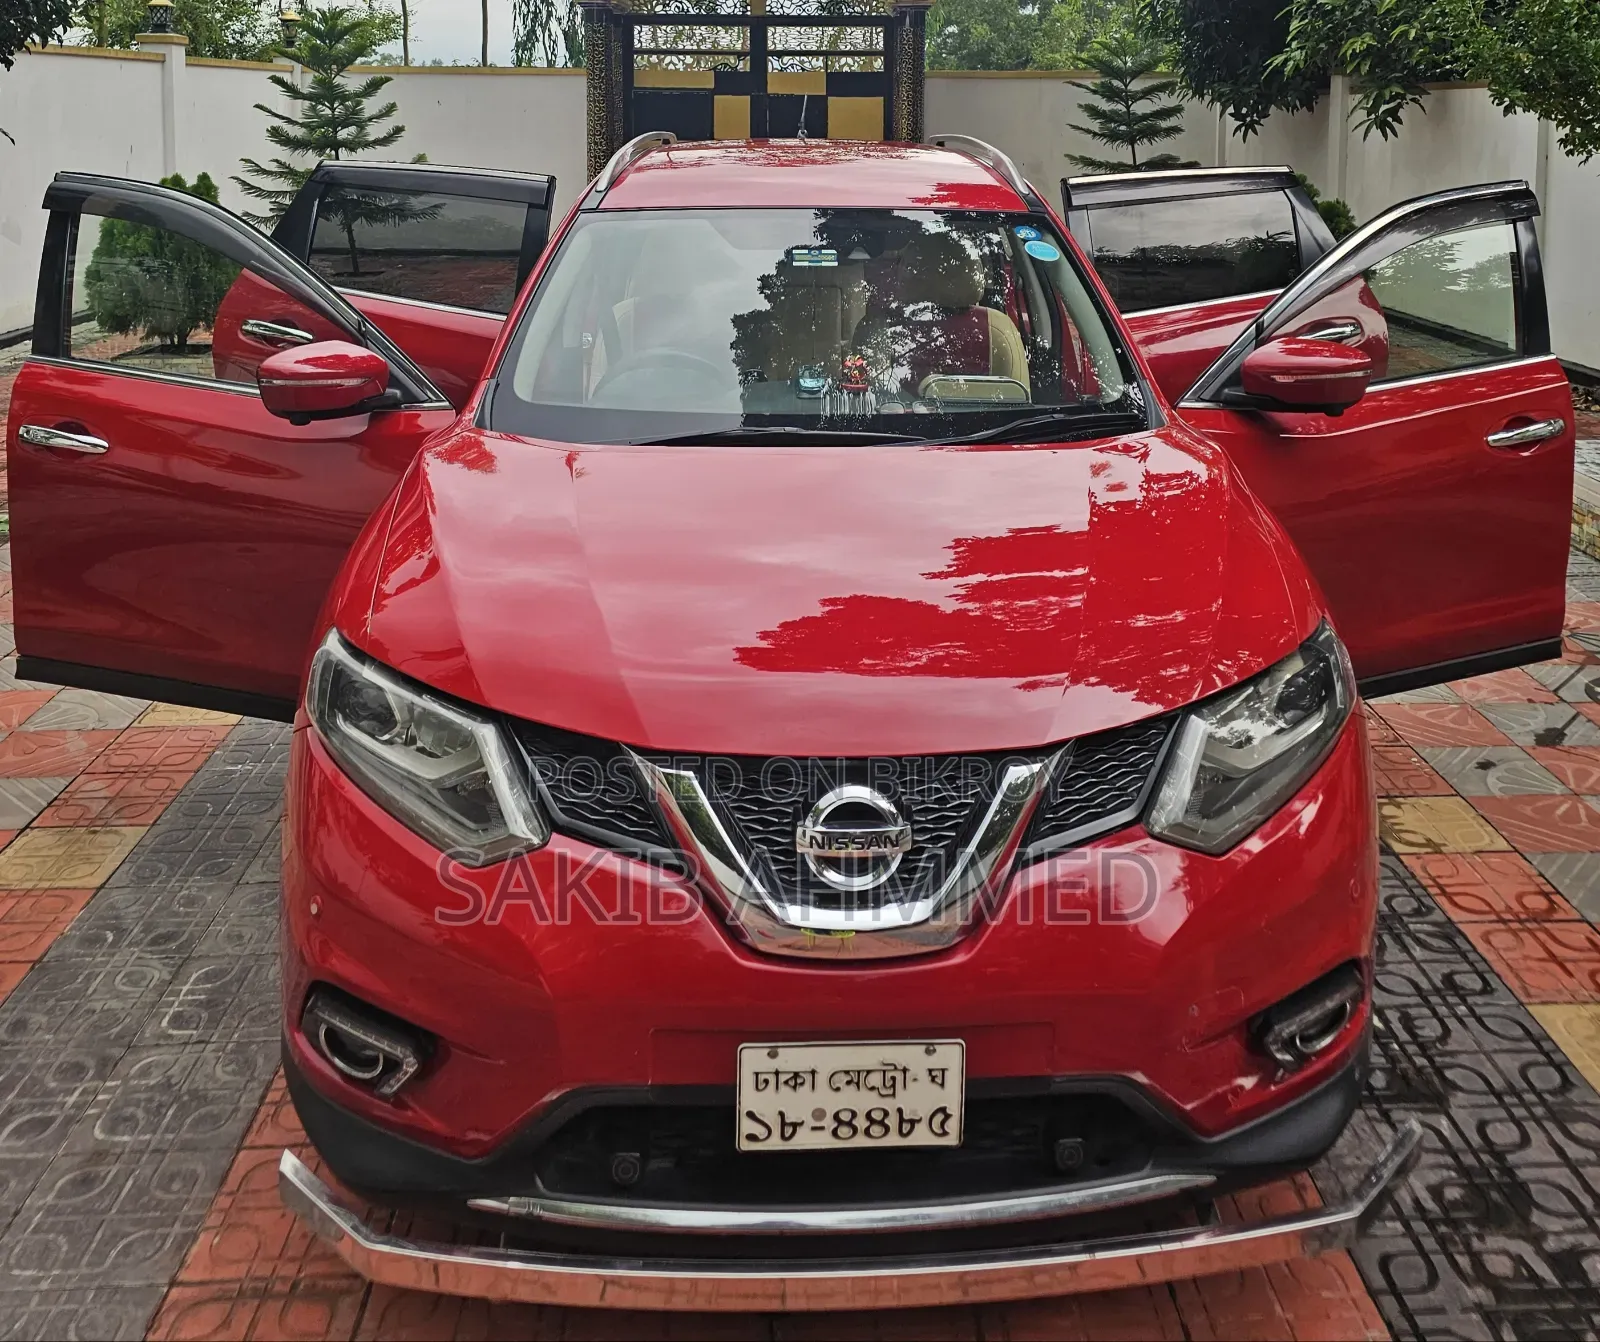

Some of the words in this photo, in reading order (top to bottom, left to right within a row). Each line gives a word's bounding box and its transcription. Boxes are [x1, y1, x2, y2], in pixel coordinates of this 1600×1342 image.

[809, 834, 900, 850] NISSAN
[753, 1067, 818, 1093] ঢাকা
[744, 1105, 953, 1143] ১৮-৪৪৮৫
